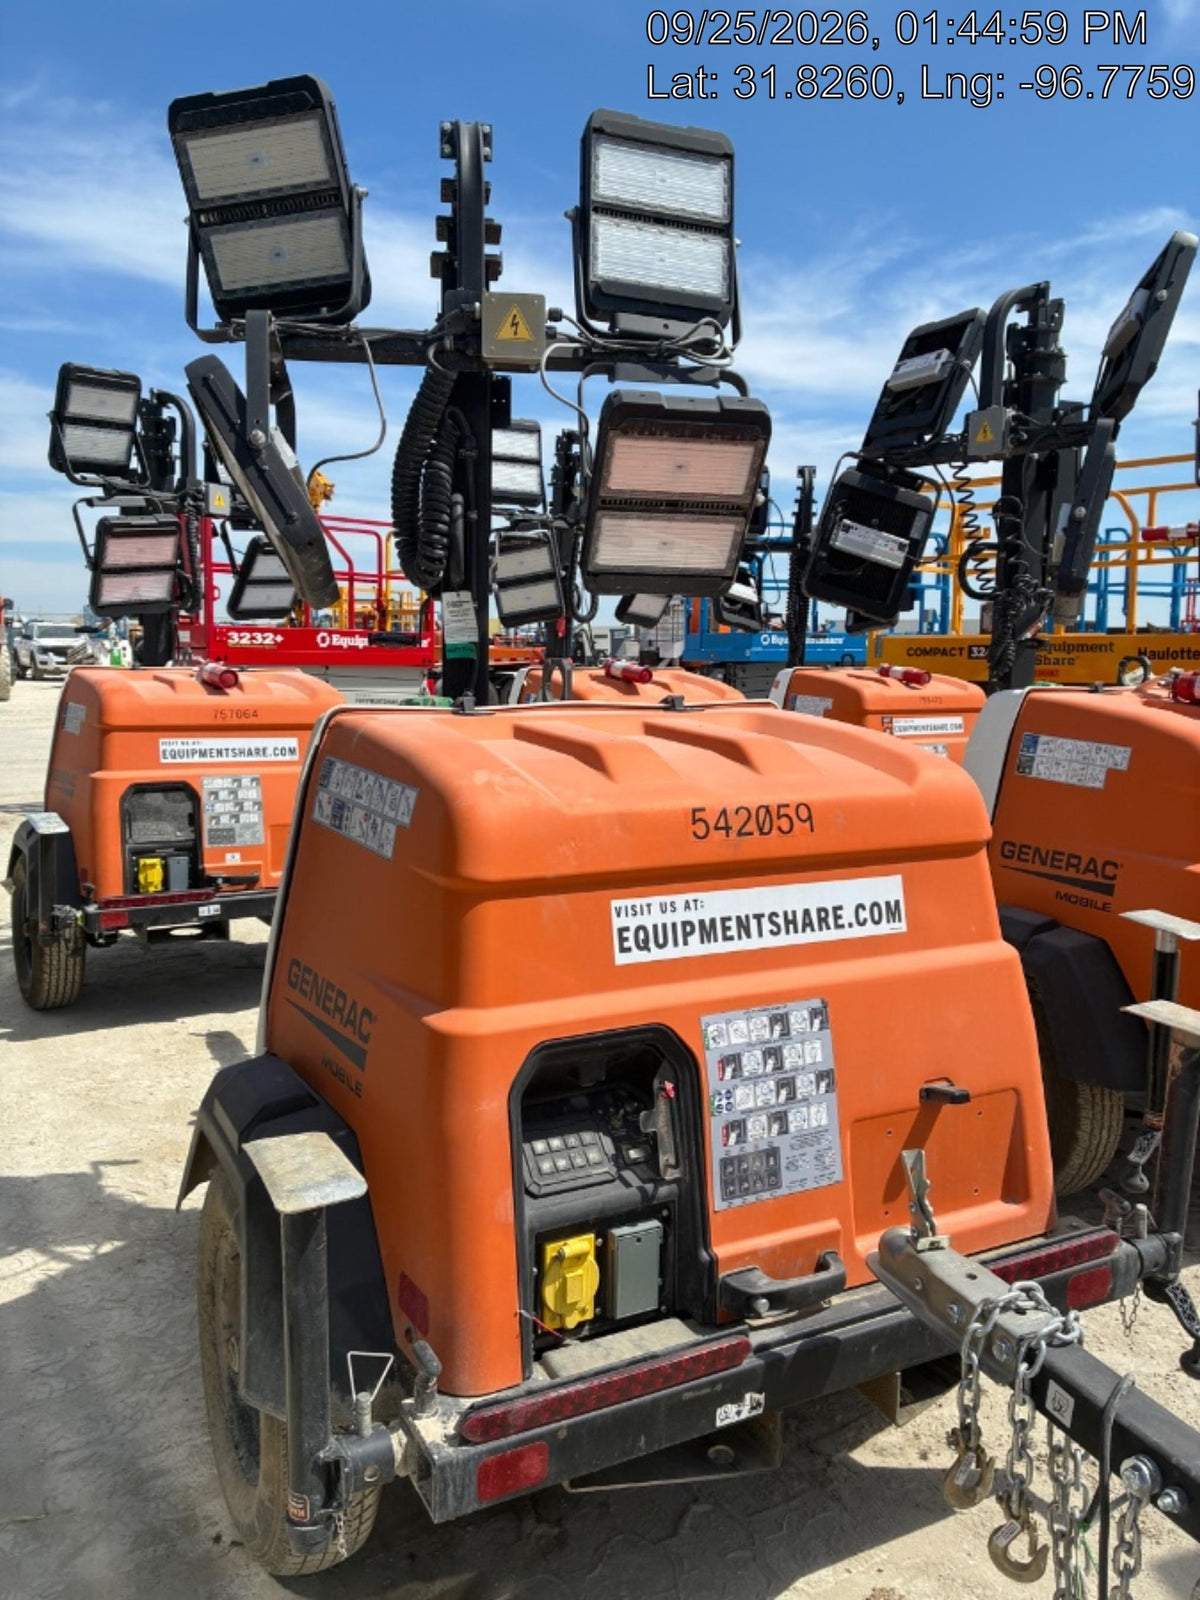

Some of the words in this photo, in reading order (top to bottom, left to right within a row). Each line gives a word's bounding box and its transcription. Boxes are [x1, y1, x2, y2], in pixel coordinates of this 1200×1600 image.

[227, 631, 284, 645] 3232+
[906, 646, 965, 658] COMPACT
[1137, 646, 1200, 661] Haulotte
[213, 709, 259, 720] 757064
[162, 746, 297, 760] EQUIPMENTSHARE.COM
[691, 802, 815, 840] 542059
[1000, 840, 1120, 881] GENERAC
[614, 902, 652, 918] VISIT
[659, 901, 677, 914] US
[683, 898, 705, 912] AT:
[1055, 890, 1112, 912] MOBILE
[616, 899, 903, 954] EQUIPMENTSHARE.COM
[287, 957, 374, 1045] GENERAC
[320, 1057, 363, 1099] MOBILE
